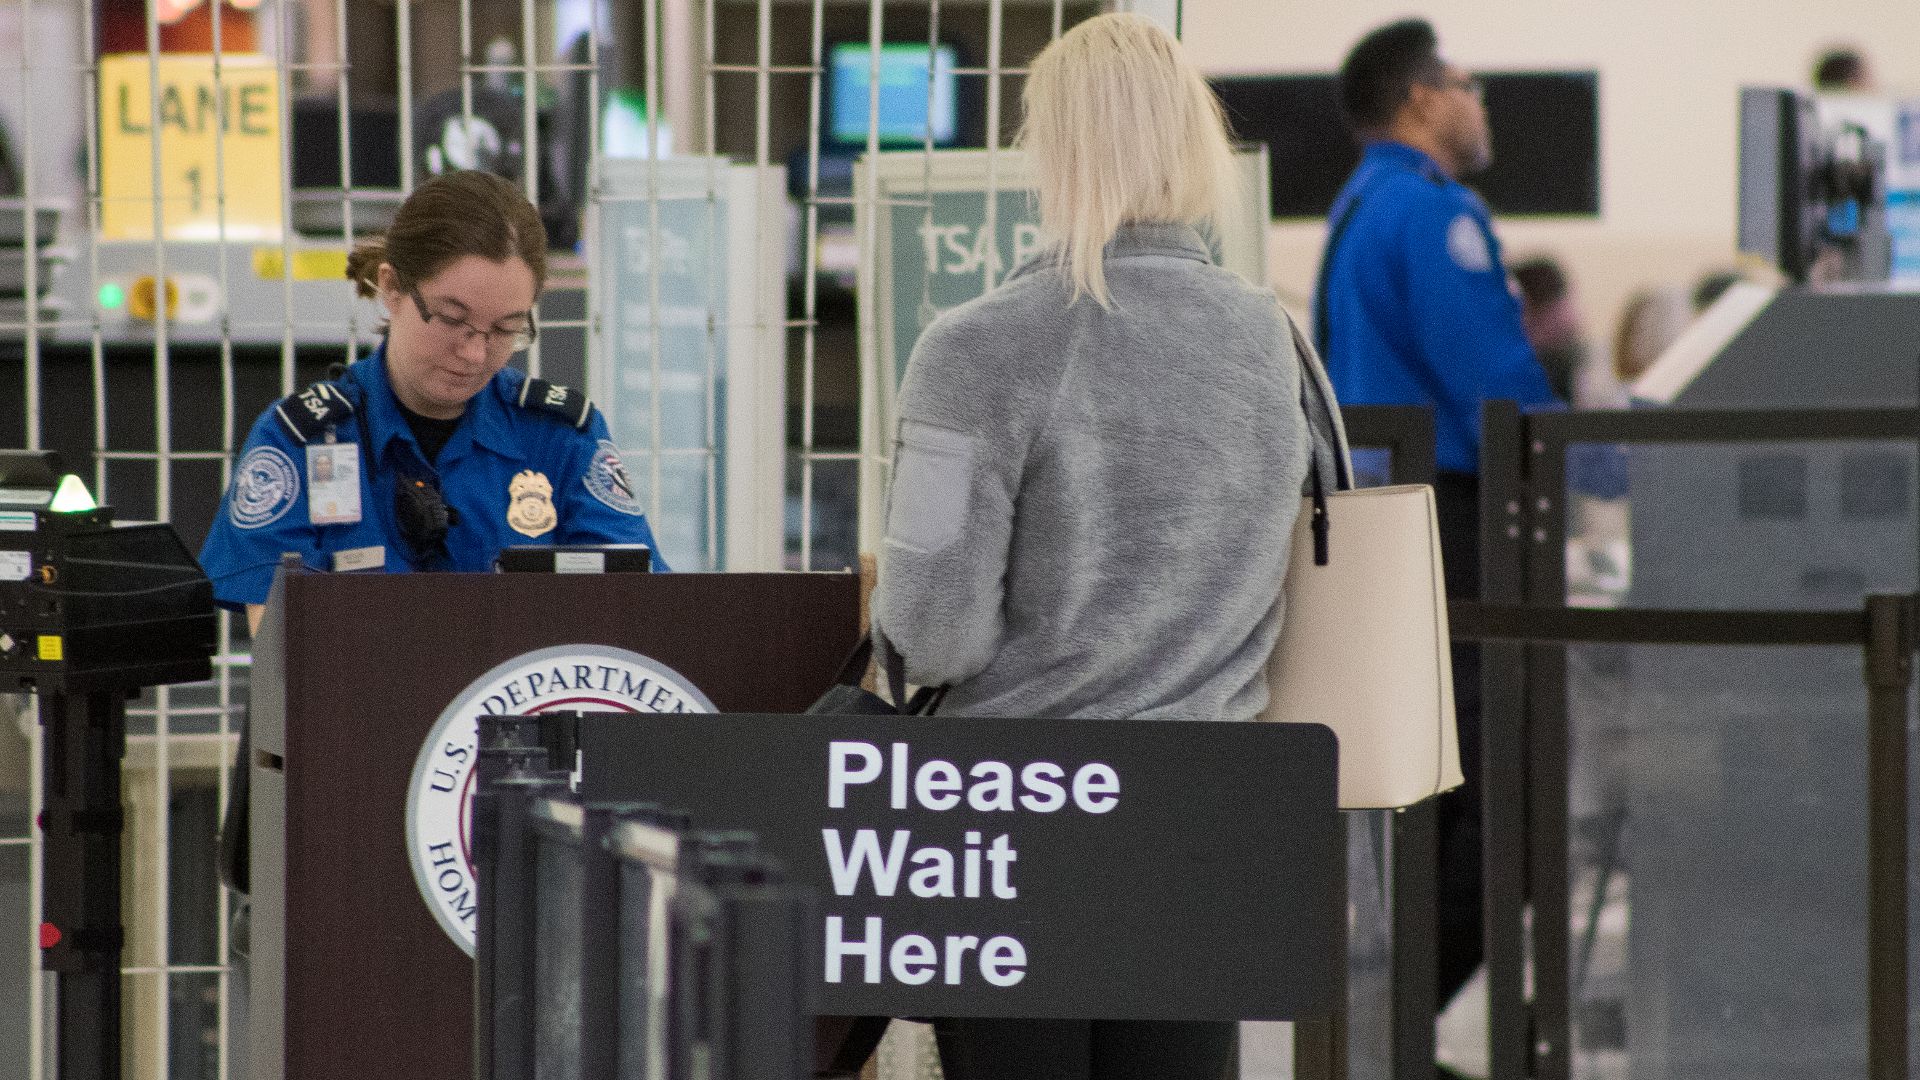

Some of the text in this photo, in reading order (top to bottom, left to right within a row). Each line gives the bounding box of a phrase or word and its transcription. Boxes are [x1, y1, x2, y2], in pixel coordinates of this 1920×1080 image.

[118, 83, 271, 135] LANE
[184, 166, 202, 214] 1
[919, 223, 1004, 273] TSA
[298, 387, 330, 421] TSA
[544, 384, 569, 406] TSA
[430, 741, 474, 796] U.S.
[828, 741, 1121, 814] Please
[429, 842, 476, 934] HOM
[822, 828, 1018, 899] Wait
[824, 916, 1028, 987] Here
